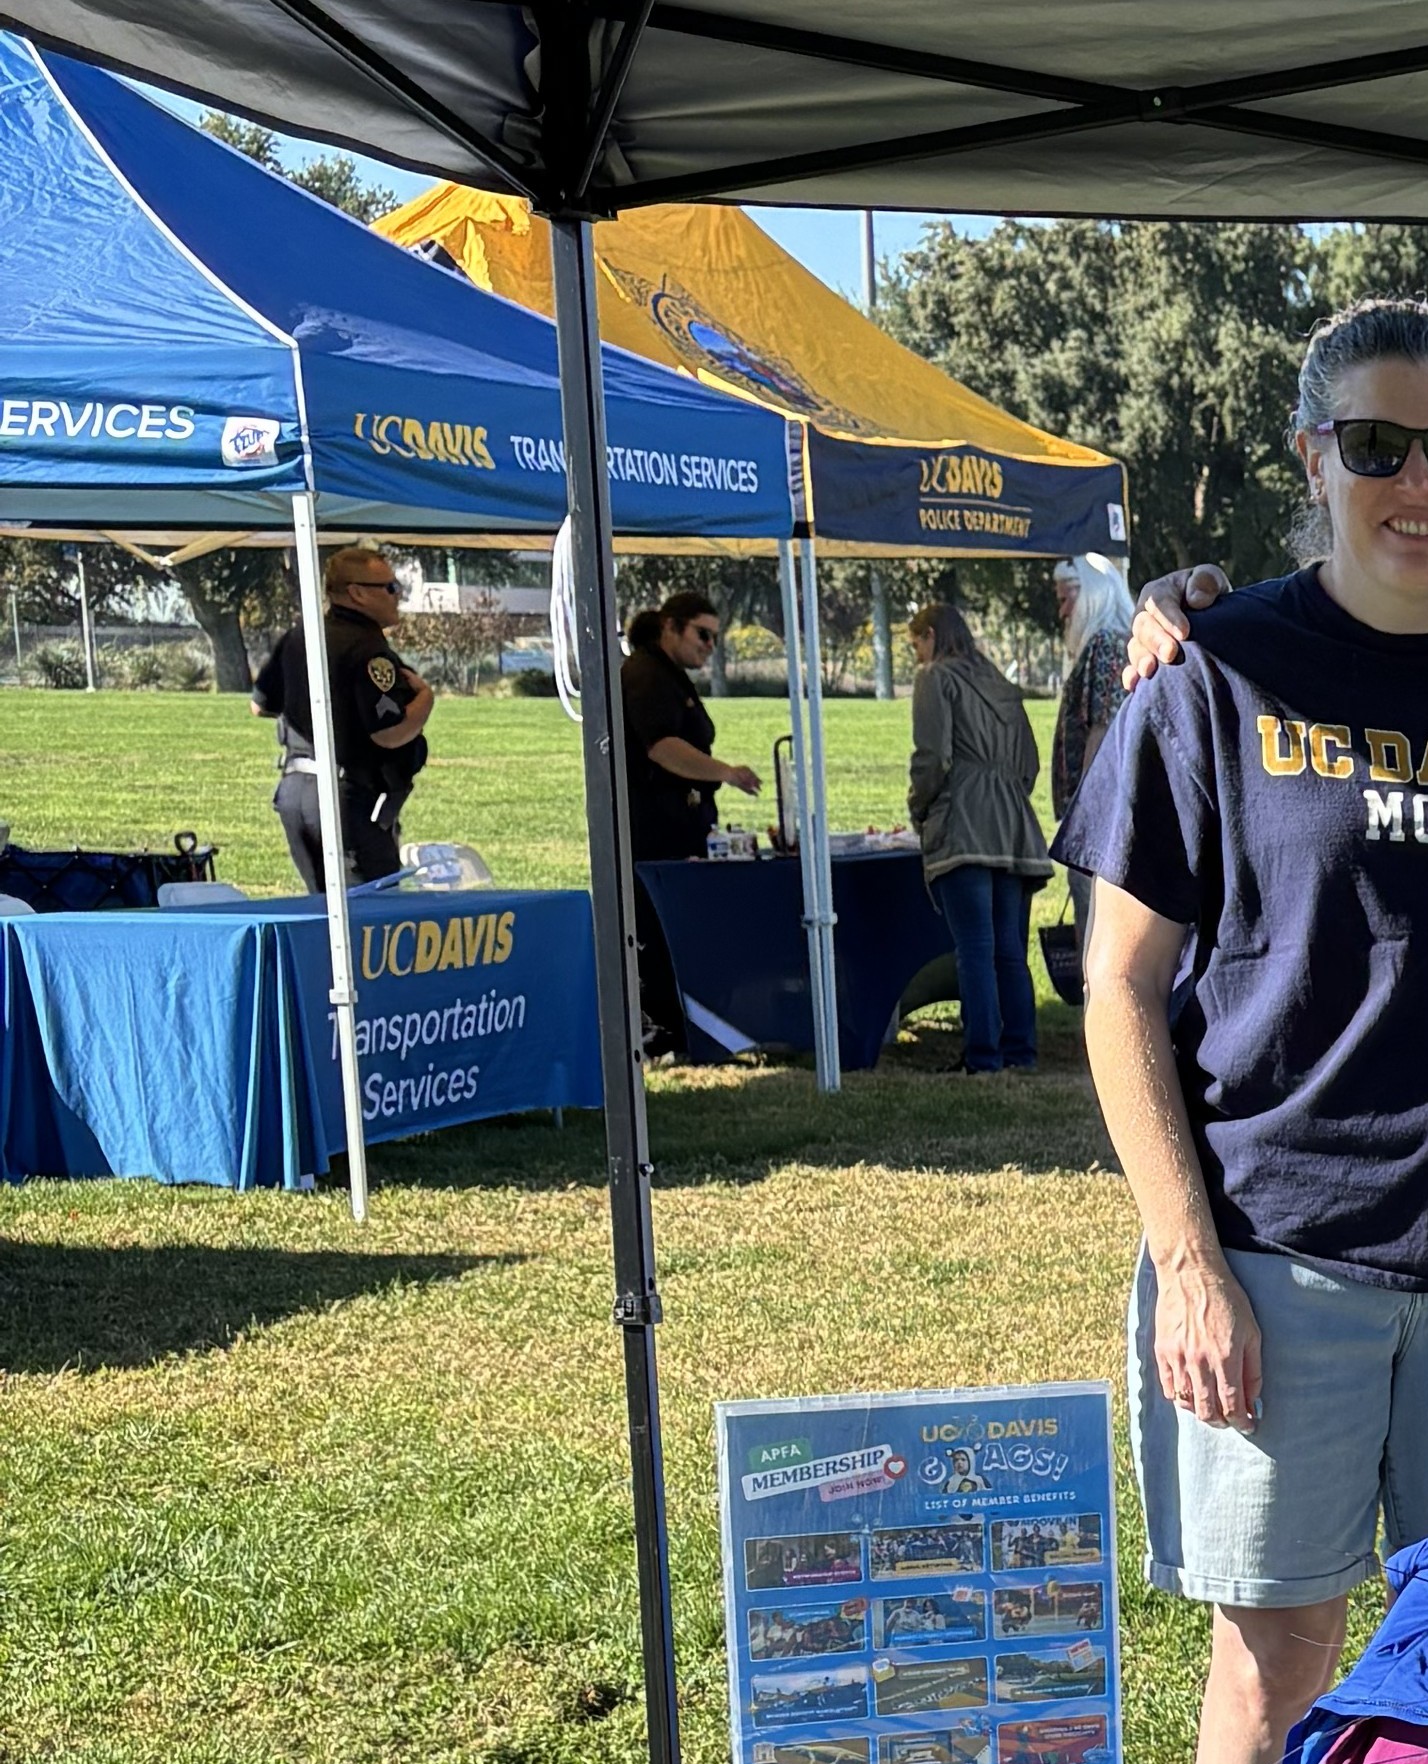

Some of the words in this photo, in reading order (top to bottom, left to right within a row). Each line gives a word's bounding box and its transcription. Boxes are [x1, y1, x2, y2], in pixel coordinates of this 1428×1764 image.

[510, 435, 679, 487] TRANRTATION
[680, 453, 759, 494] SERVICES
[919, 508, 961, 531] POLICE
[963, 510, 1032, 538] DEPARTMENT
[1256, 714, 1355, 780] UC
[327, 988, 526, 1061] Tansportation
[362, 1062, 480, 1121] Services
[987, 1417, 1059, 1440] DAVIS
[751, 1449, 885, 1493] MEMBERSHIP
[760, 1443, 803, 1463] APFA
[924, 1499, 950, 1511] LIST
[952, 1497, 968, 1508] OF
[971, 1494, 1021, 1508] MEMBER
[1022, 1490, 1077, 1504] BENEFITS
